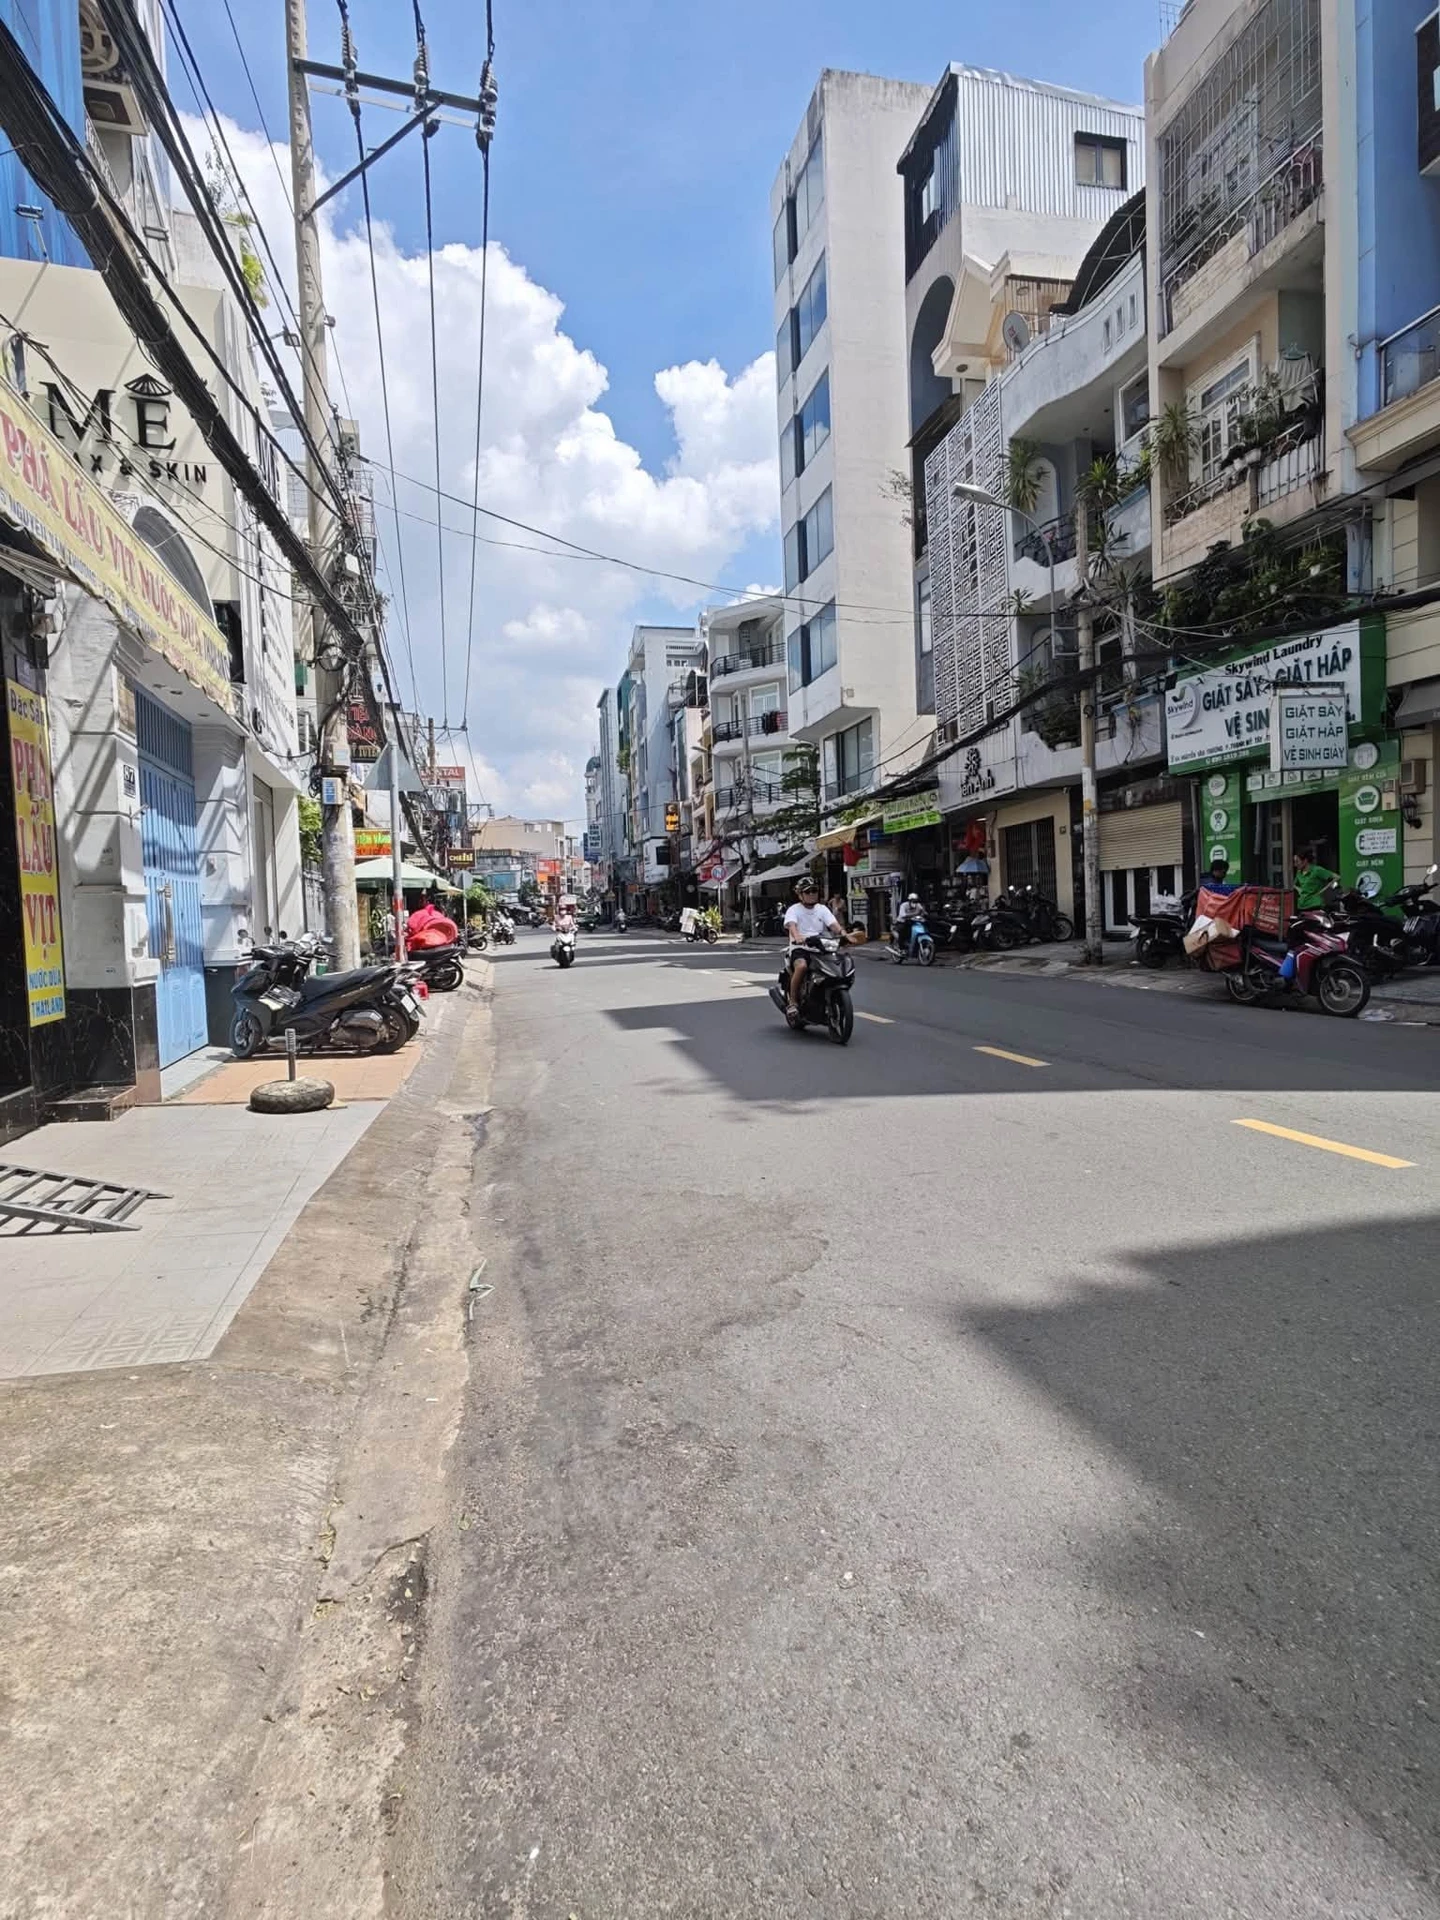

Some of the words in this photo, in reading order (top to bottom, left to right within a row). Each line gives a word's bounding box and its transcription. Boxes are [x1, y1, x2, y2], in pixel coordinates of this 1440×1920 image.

[149, 460, 208, 483] SKIN
[1225, 652, 1270, 676] Skywind
[1273, 634, 1323, 661] Laundry
[1202, 683, 1232, 712] GIẶT
[1317, 640, 1352, 679] HẤP
[1245, 707, 1270, 733] SIN
[1285, 704, 1315, 721] GIẶT
[1285, 724, 1315, 742] GIẶT
[1284, 745, 1296, 765] VỆ
[1299, 747, 1320, 760] SINH
[25, 893, 56, 961] VỊT
